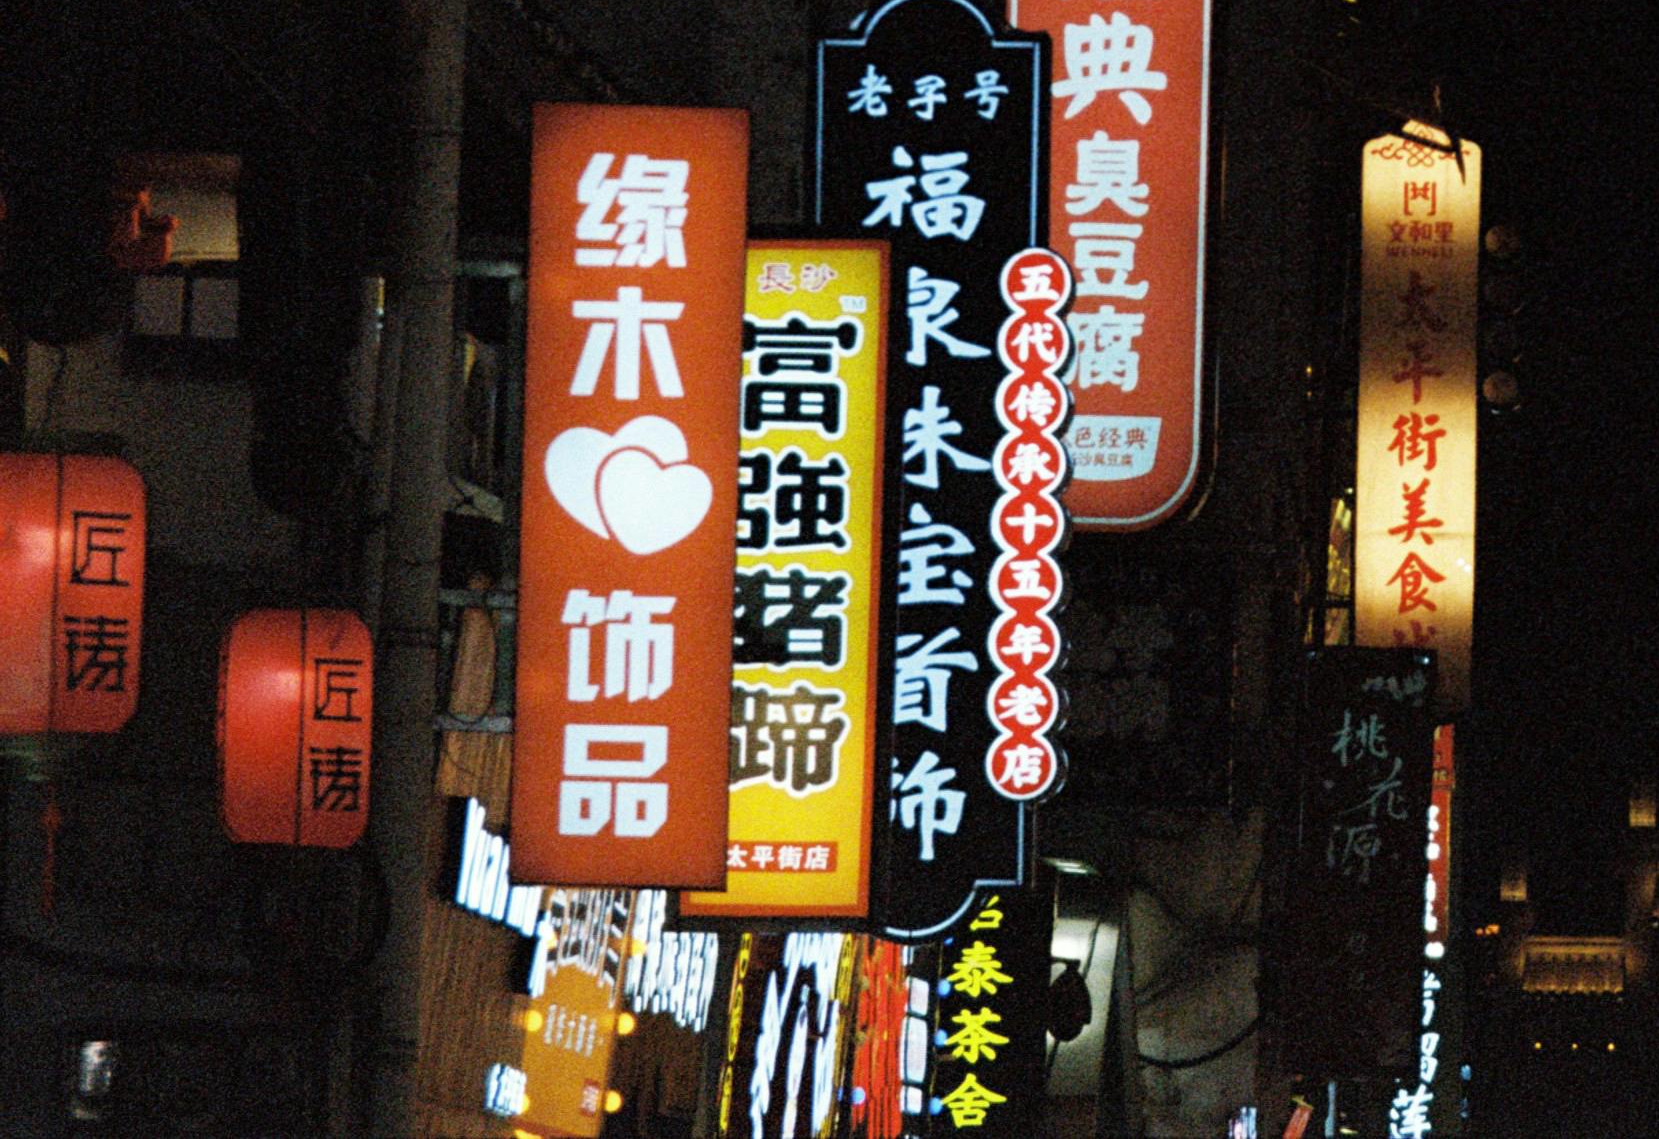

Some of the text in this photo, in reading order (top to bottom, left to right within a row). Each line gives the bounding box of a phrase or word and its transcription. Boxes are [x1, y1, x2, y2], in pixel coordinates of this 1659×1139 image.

[569, 152, 690, 401] 缘木
[1066, 427, 1149, 449] 色经典
[557, 589, 678, 839] 饰品
[727, 844, 830, 870] 太平街店
